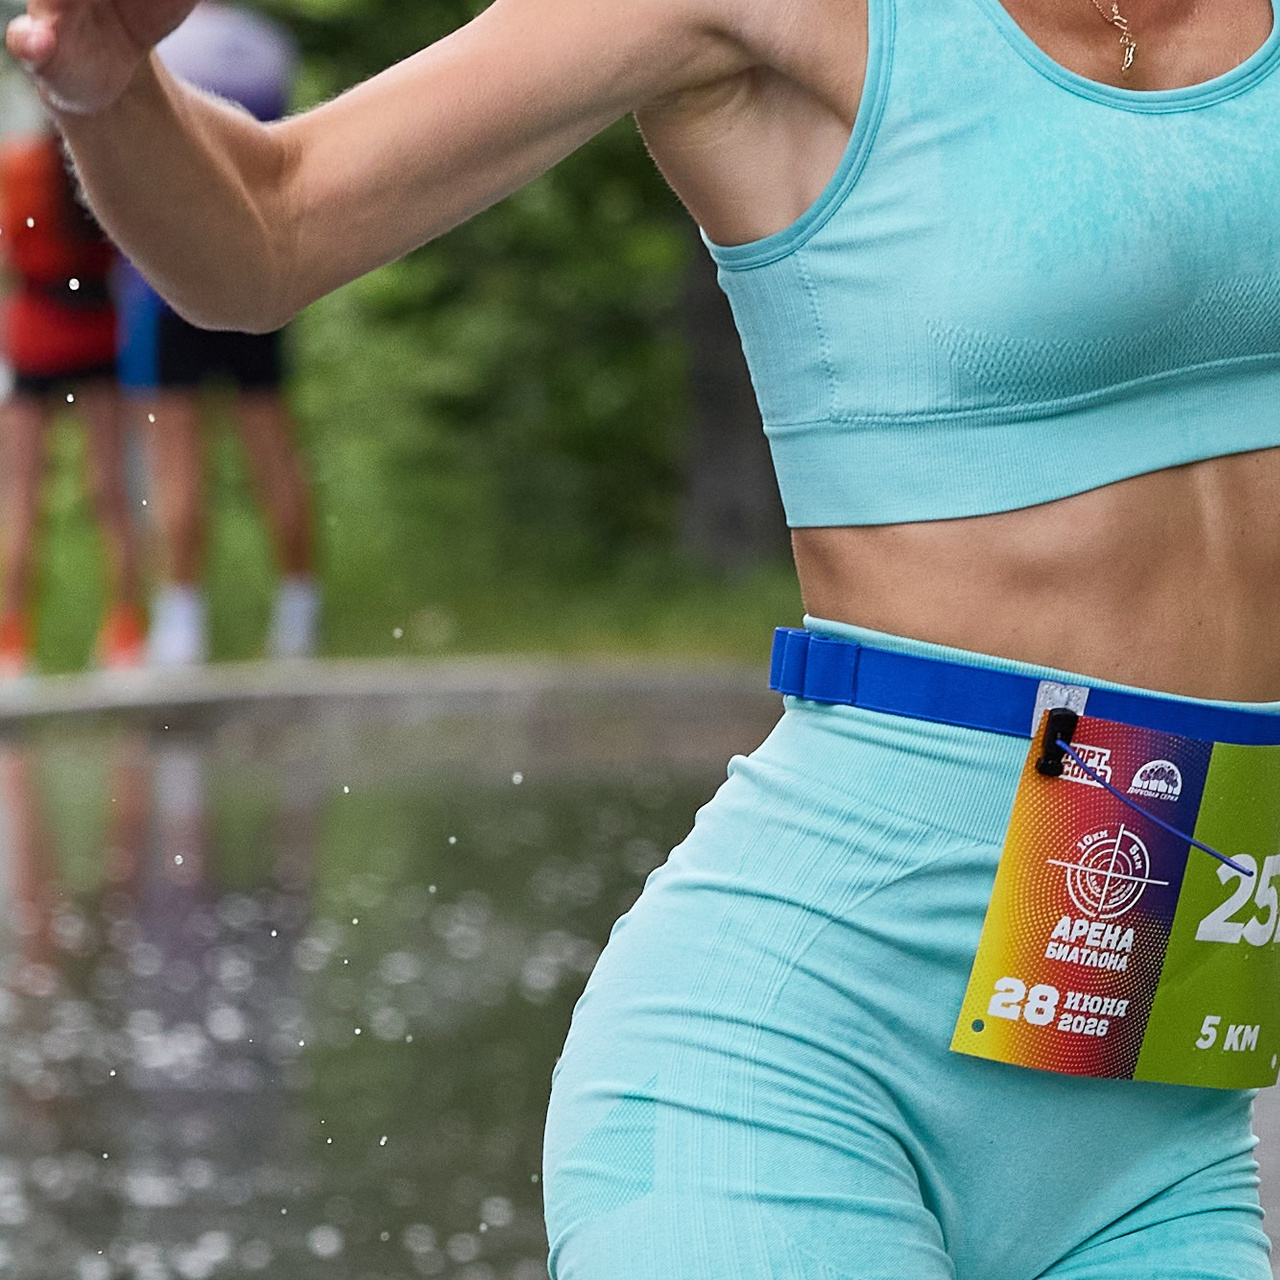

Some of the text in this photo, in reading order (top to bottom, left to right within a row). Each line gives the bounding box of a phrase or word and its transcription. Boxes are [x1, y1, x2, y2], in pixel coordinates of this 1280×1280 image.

[1050, 915, 1135, 952] АРЕНА
[1045, 940, 1128, 972] БИАТЛОНА
[987, 976, 1130, 1026] 28 ИЮНЯ
[1057, 1013, 1110, 1037] 2026
[1195, 1015, 1222, 1050] 5
